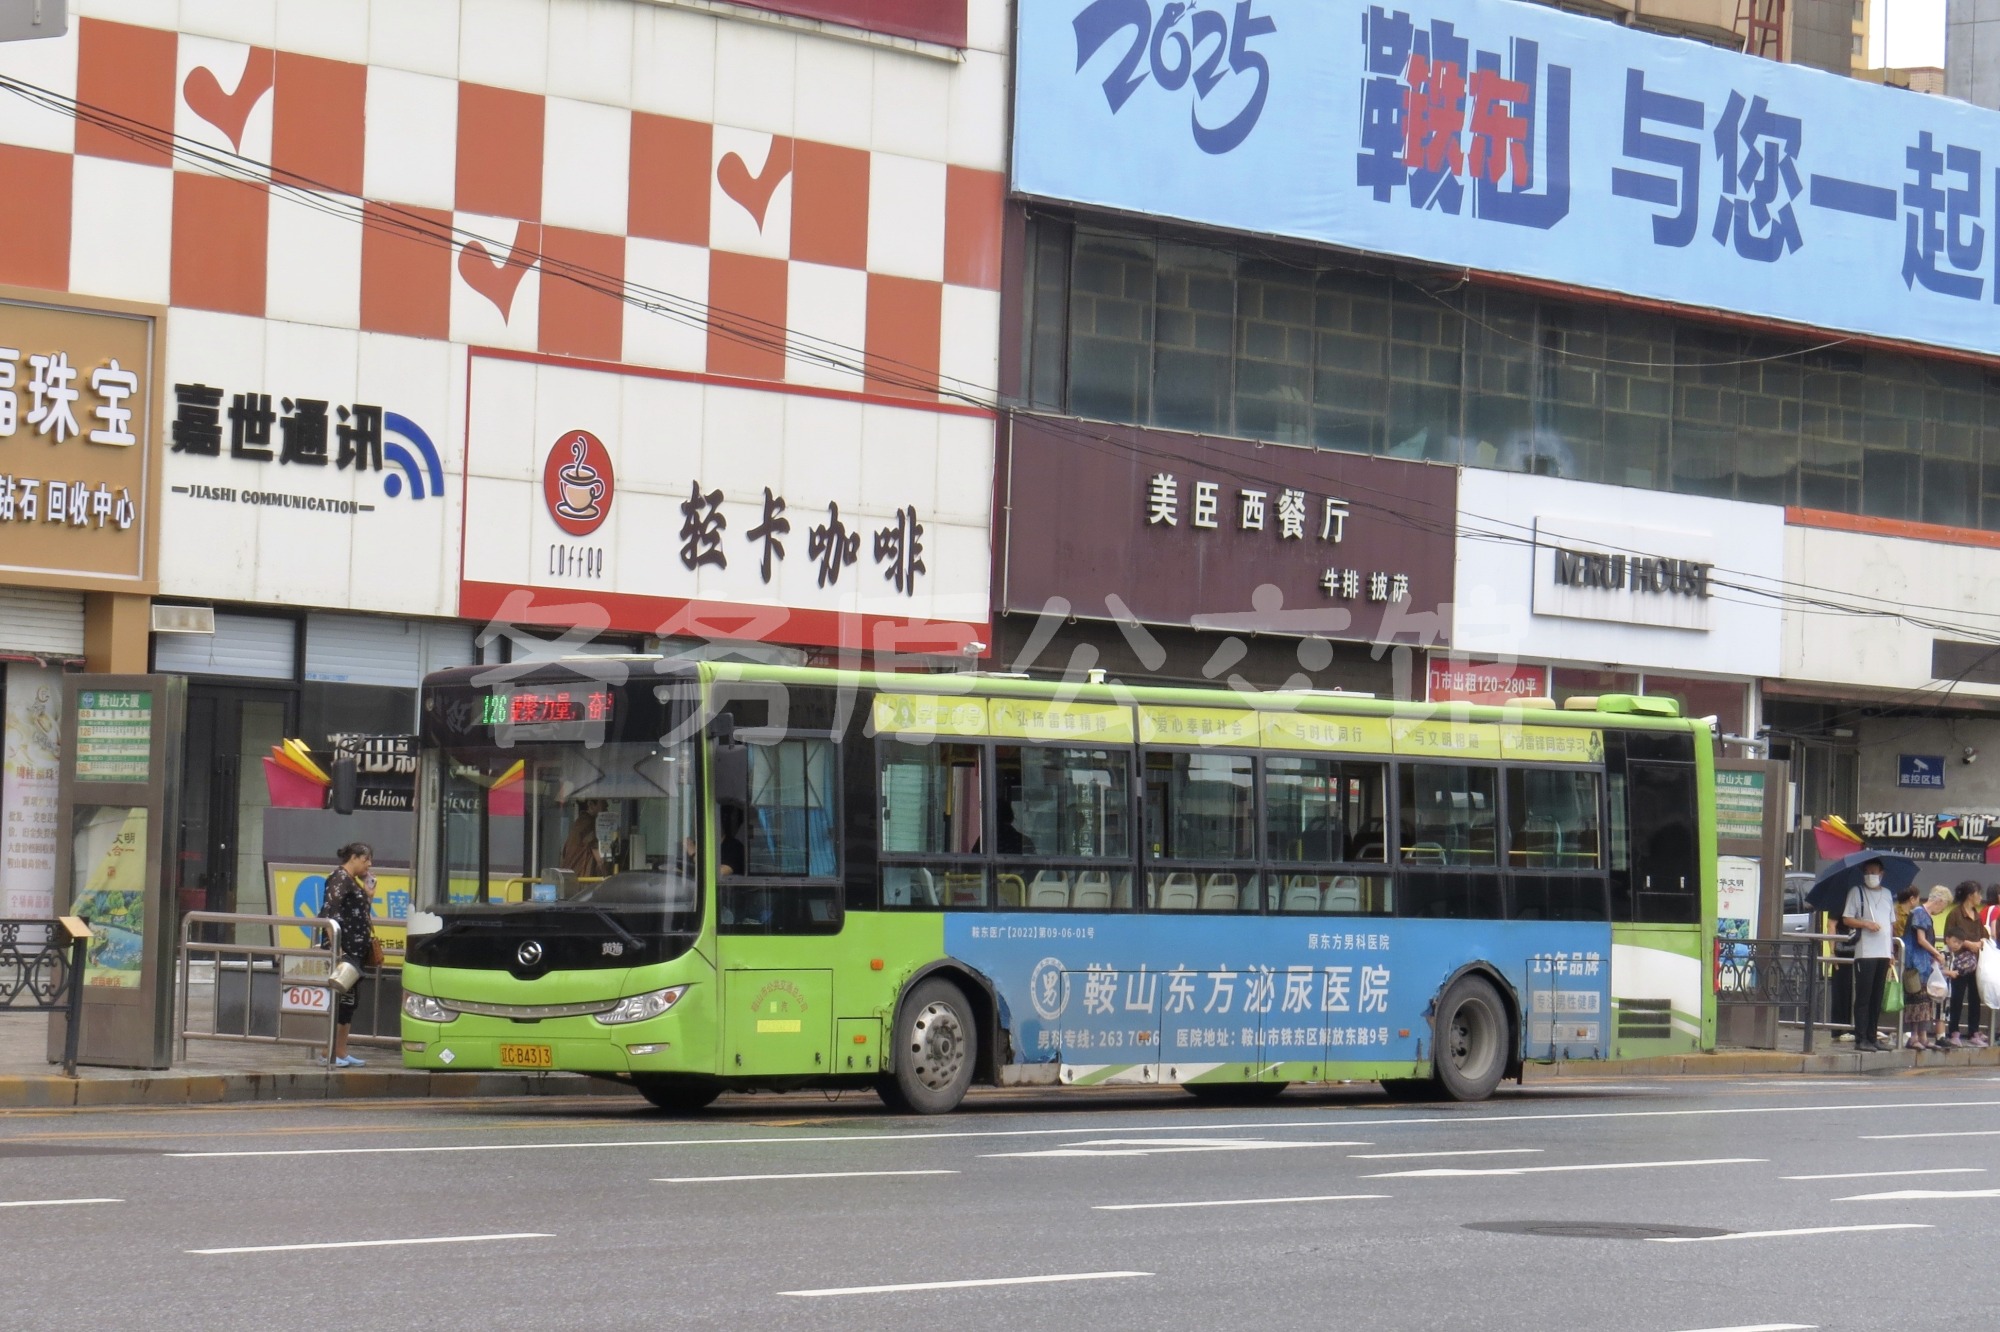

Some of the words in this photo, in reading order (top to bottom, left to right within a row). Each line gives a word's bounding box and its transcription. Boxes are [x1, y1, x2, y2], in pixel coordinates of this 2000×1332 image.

[1072, 0, 1278, 156] 2025
[1402, 53, 1529, 187] 铁东
[1612, 68, 2000, 305] 与您一起
[171, 383, 384, 471] 嘉世通讯
[189, 484, 237, 503] JIASHI
[241, 489, 359, 515] COMMUNICATION
[1149, 473, 1350, 543] 美臣西餐厅
[680, 479, 927, 598] 轻卡咖啡
[1322, 567, 1360, 600] 牛排
[1369, 571, 1410, 603] 披萨
[1630, 557, 1715, 600] HOUSE
[98, 693, 140, 708] 鞍山大厦
[483, 695, 507, 724] 126
[1156, 715, 1244, 737] 爱心奉献社会
[1295, 724, 1363, 743] 与时代同行
[1716, 774, 1753, 786] 鞍山大厦
[1900, 773, 1942, 786] 监控区域
[1717, 878, 1744, 887] 华文明
[1308, 933, 1390, 951] 原东方男科医院
[1532, 951, 1600, 976] 13年品牌
[290, 987, 324, 1007] 602
[1083, 962, 1391, 1015] 鞍山东方泌尿医院
[1099, 1030, 1123, 1048] 263
